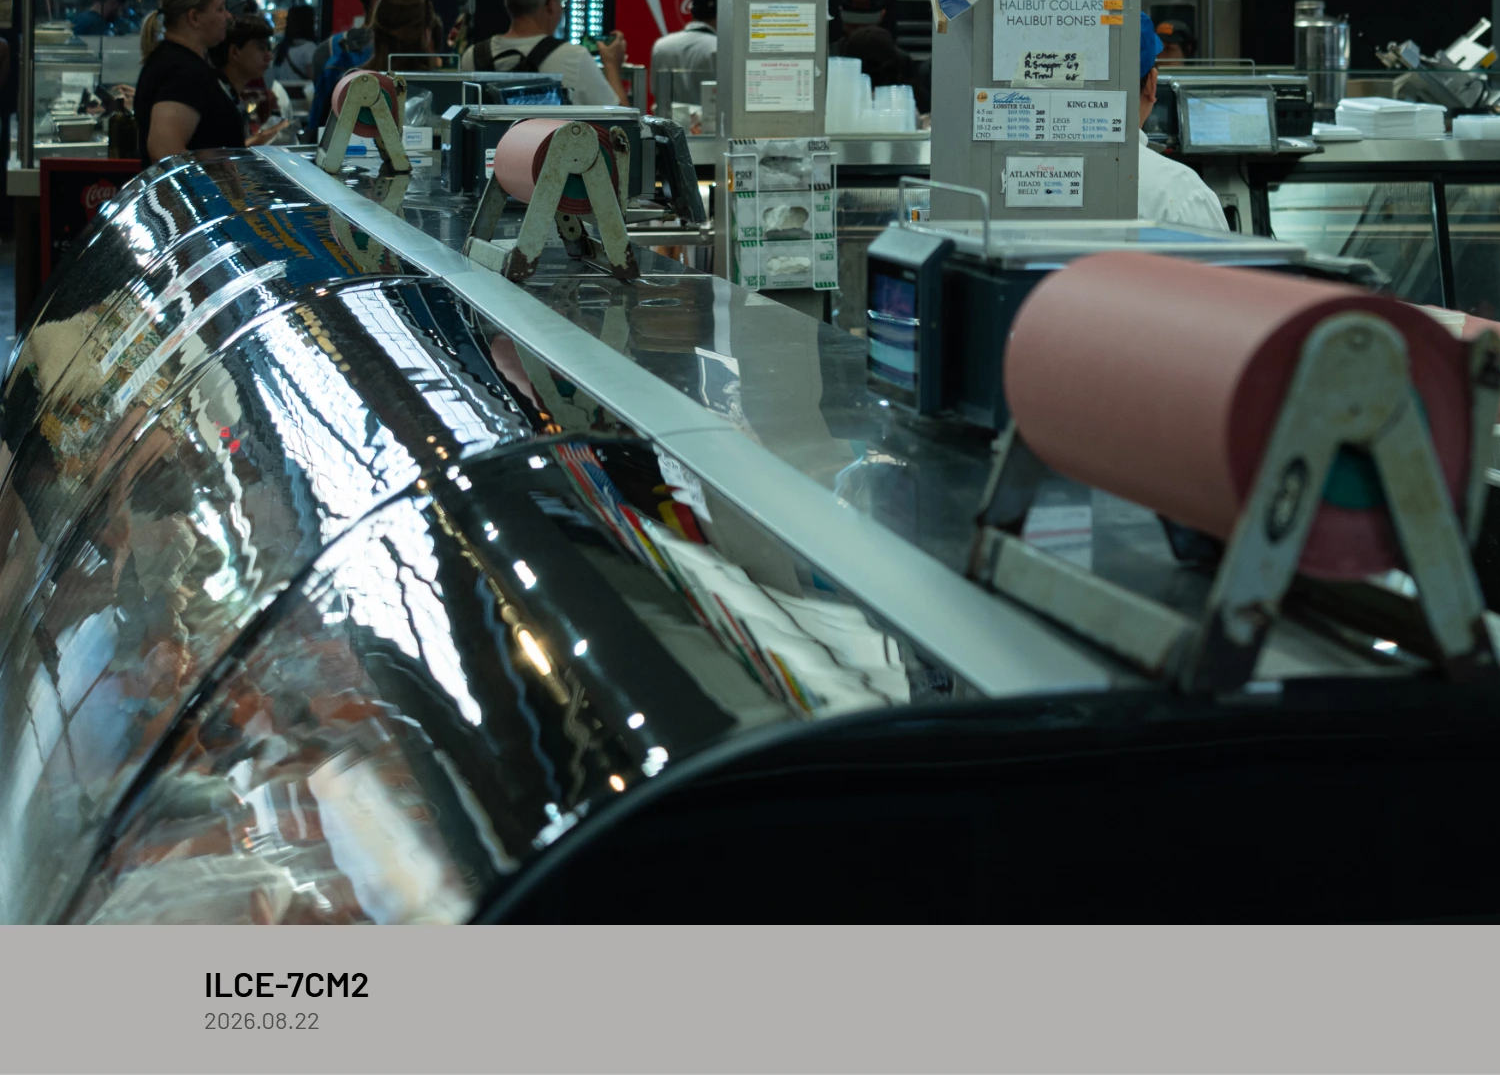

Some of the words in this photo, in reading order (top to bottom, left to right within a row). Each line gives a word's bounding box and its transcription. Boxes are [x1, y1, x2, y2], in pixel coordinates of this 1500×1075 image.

[999, 0, 1046, 11] HALIBUT
[1049, 0, 1104, 11] COLLARS
[1006, 15, 1054, 26] HALIBUT
[1057, 15, 1096, 26] BONES
[1066, 62, 1079, 70] 69
[1067, 101, 1086, 109] KING
[1088, 101, 1109, 109] CRAB
[735, 170, 753, 179] POLY
[1009, 171, 1048, 179] ATLANTIC
[1049, 171, 1082, 179] SALMON
